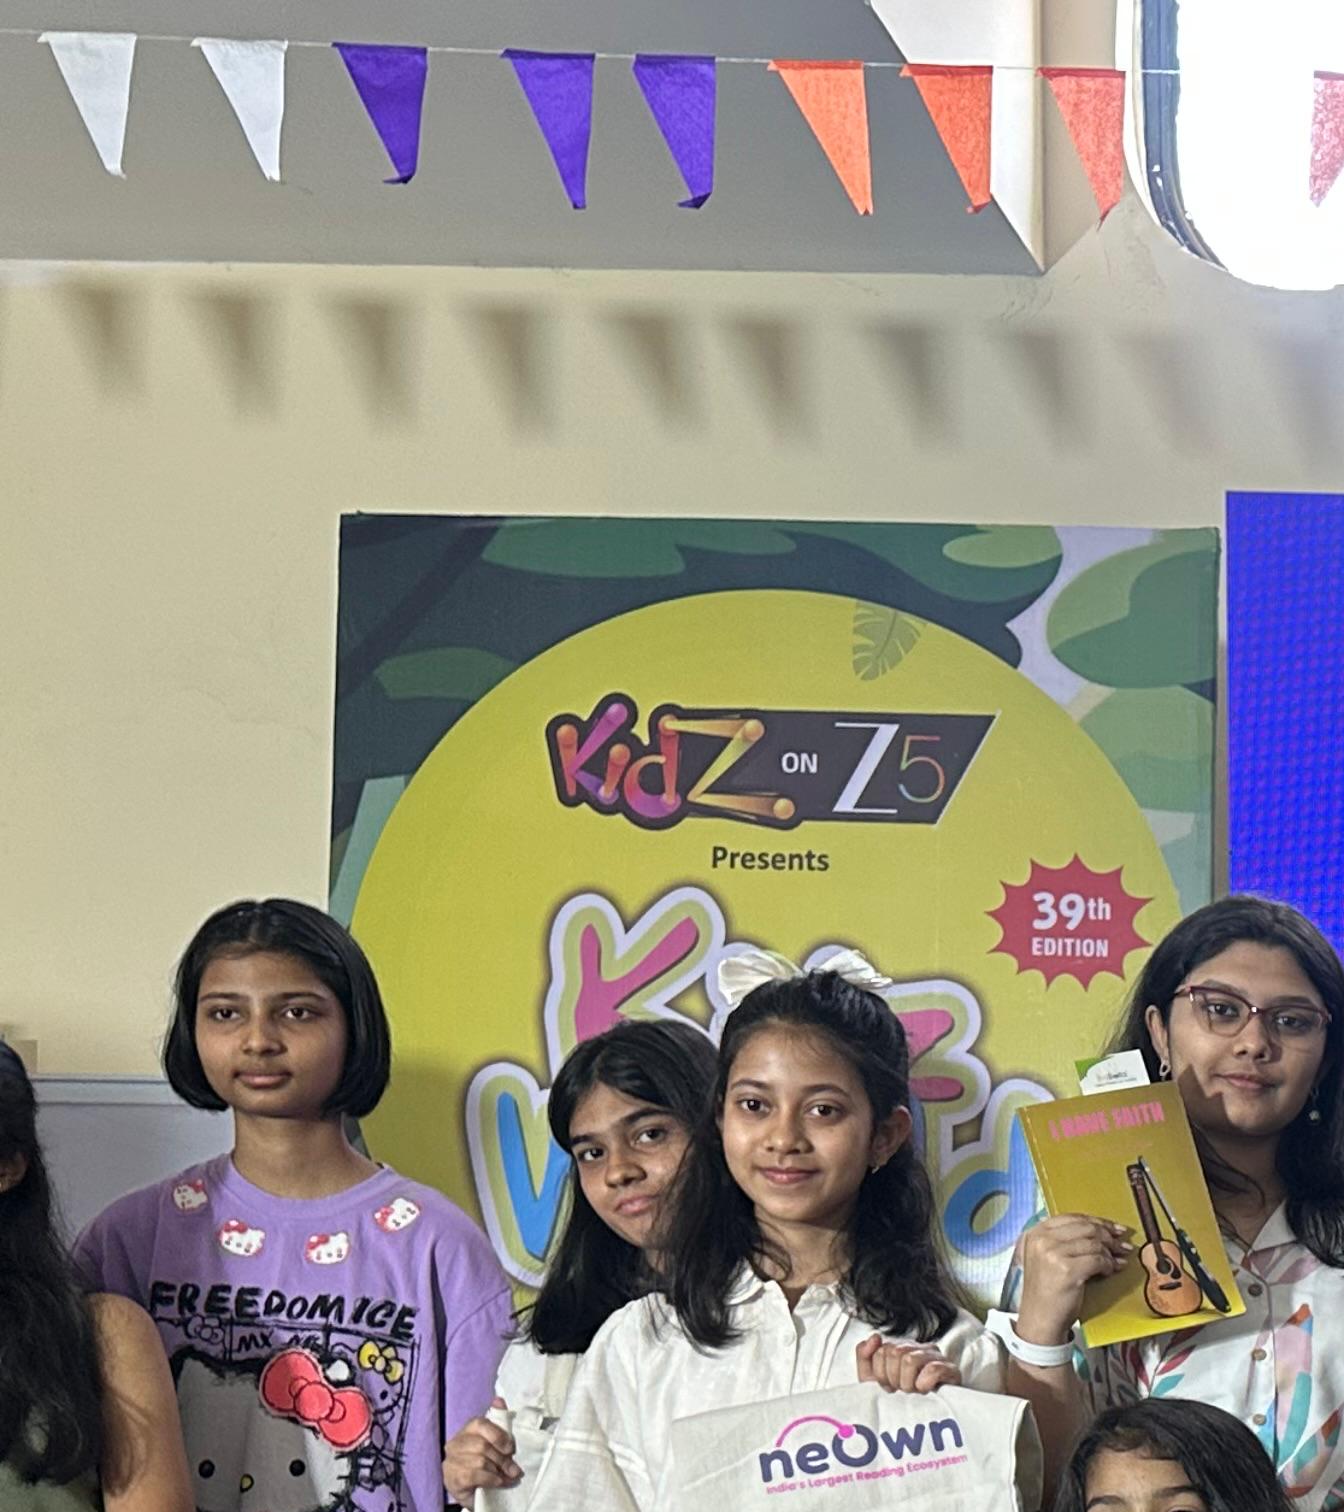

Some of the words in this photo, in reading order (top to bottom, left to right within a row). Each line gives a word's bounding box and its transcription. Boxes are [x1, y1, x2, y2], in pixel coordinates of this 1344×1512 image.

[781, 752, 817, 774] ON
[832, 721, 945, 814] Z5
[711, 846, 830, 872] Presents
[1031, 891, 1112, 931] 39th
[1031, 936, 1109, 958] EDITION
[150, 1281, 345, 1324] FREEDOM
[759, 1416, 963, 1484] neOwn
[808, 1473, 854, 1489] Largest
[856, 1466, 905, 1481] Reading
[906, 1454, 969, 1473] Ecosystem
